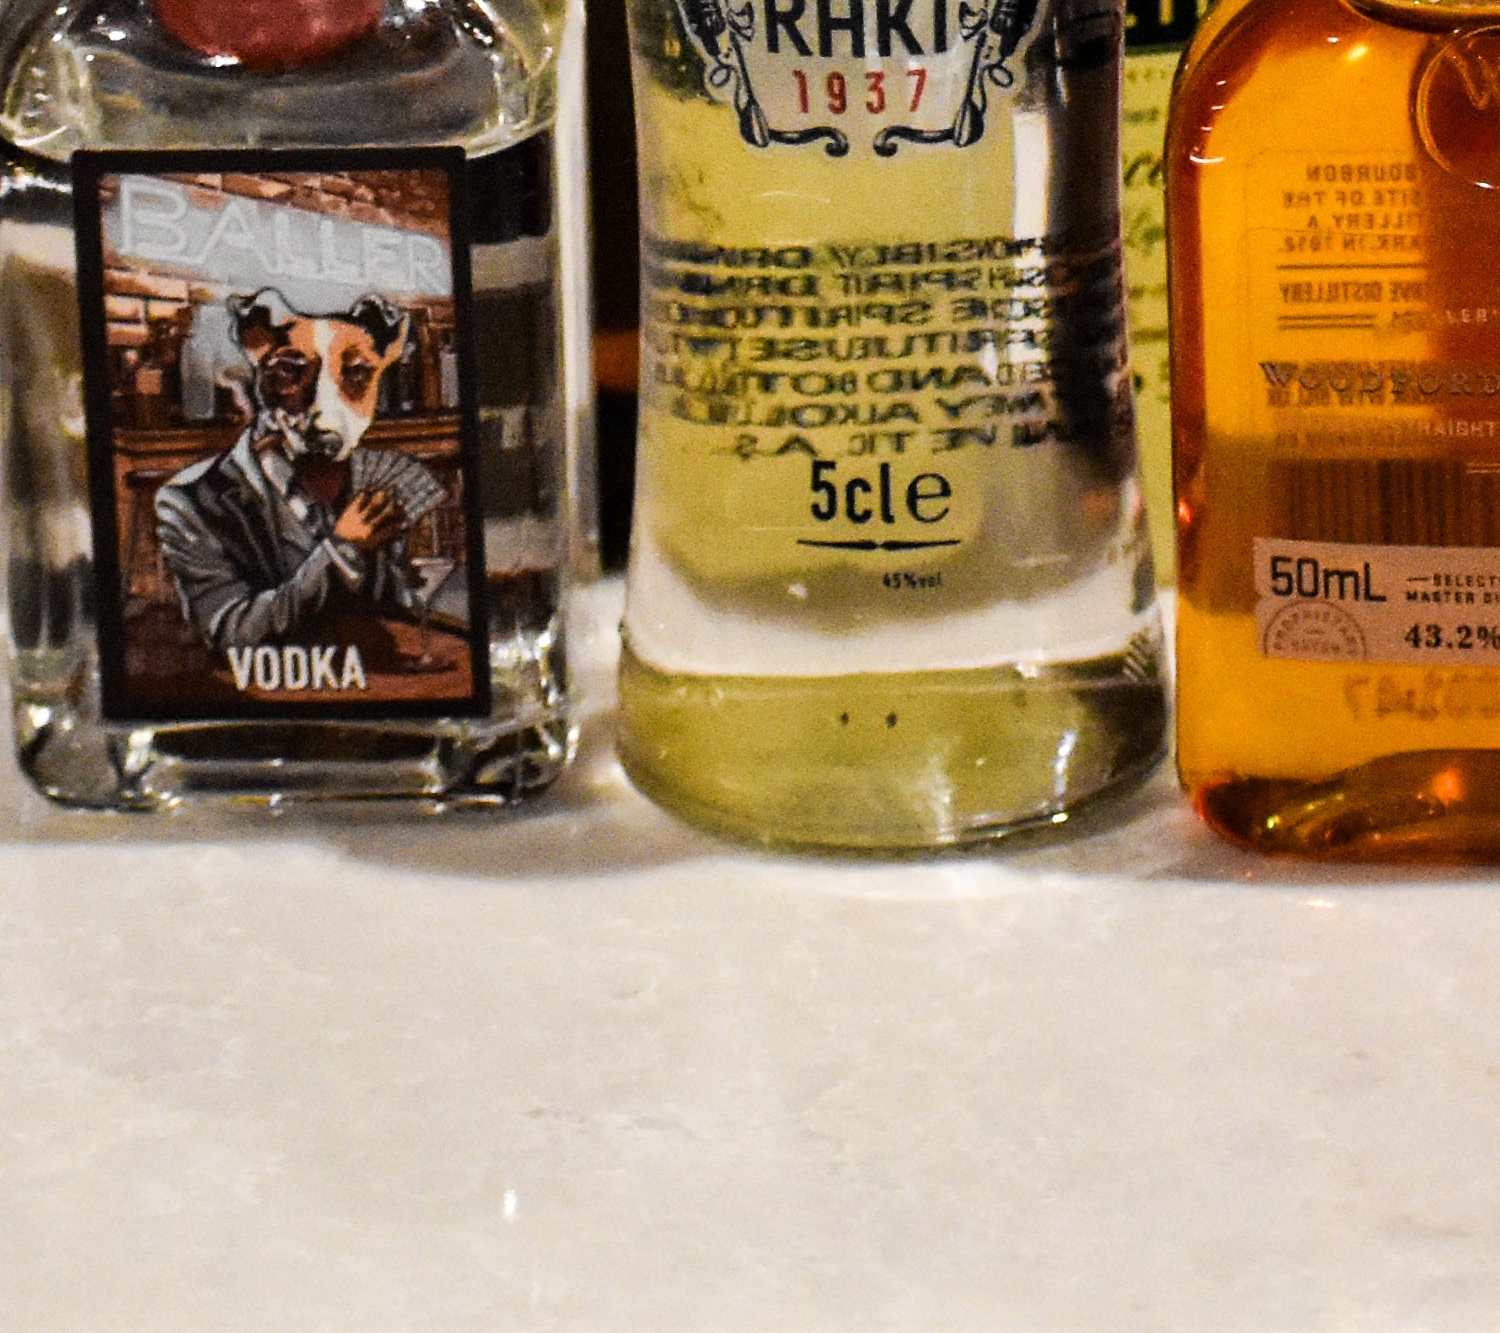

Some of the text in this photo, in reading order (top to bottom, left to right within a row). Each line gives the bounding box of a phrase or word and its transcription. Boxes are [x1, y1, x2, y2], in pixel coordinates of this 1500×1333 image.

[793, 68, 928, 115] 1937
[118, 173, 453, 296] BALLER
[1270, 555, 1387, 603] 50mL
[1406, 589, 1475, 604] MASTER
[227, 644, 368, 692] VODKA
